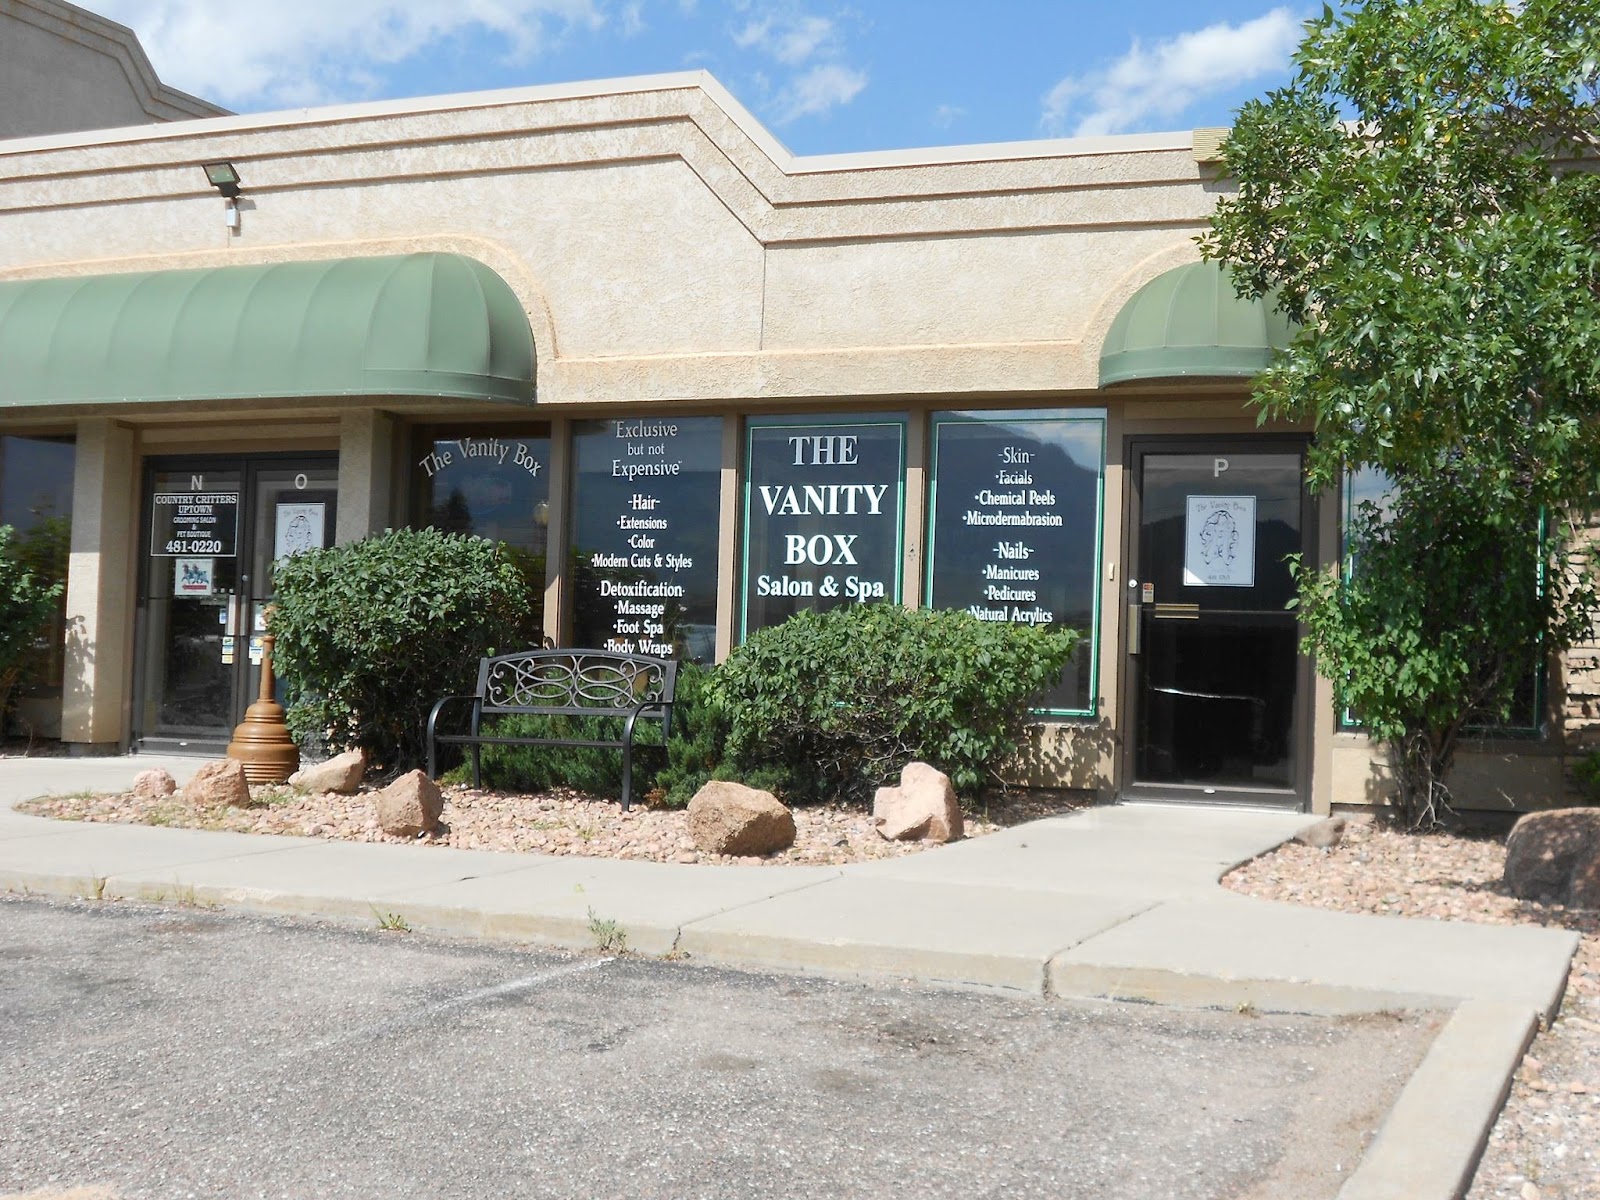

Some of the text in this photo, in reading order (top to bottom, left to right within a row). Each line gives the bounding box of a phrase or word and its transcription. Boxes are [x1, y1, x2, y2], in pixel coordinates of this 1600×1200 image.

[418, 437, 542, 477] The Vanity Box
[627, 442, 665, 456] but not
[788, 435, 859, 466] THE
[1214, 458, 1230, 478] P
[191, 475, 203, 491] N
[155, 495, 237, 505] COUNTRY CRITTERS
[758, 484, 889, 517] VANITY
[1029, 489, 1056, 506] Peels
[178, 505, 213, 515] UPTOWN
[165, 540, 222, 553] 481-0220
[784, 534, 859, 566] BOX
[630, 553, 652, 568] Cuts
[653, 553, 663, 568] &
[665, 553, 693, 572] Styles
[757, 574, 885, 603] Salon & Spa
[1011, 606, 1053, 627] Acrylics
[643, 619, 664, 638] Spa
[638, 639, 673, 658] Wraps
